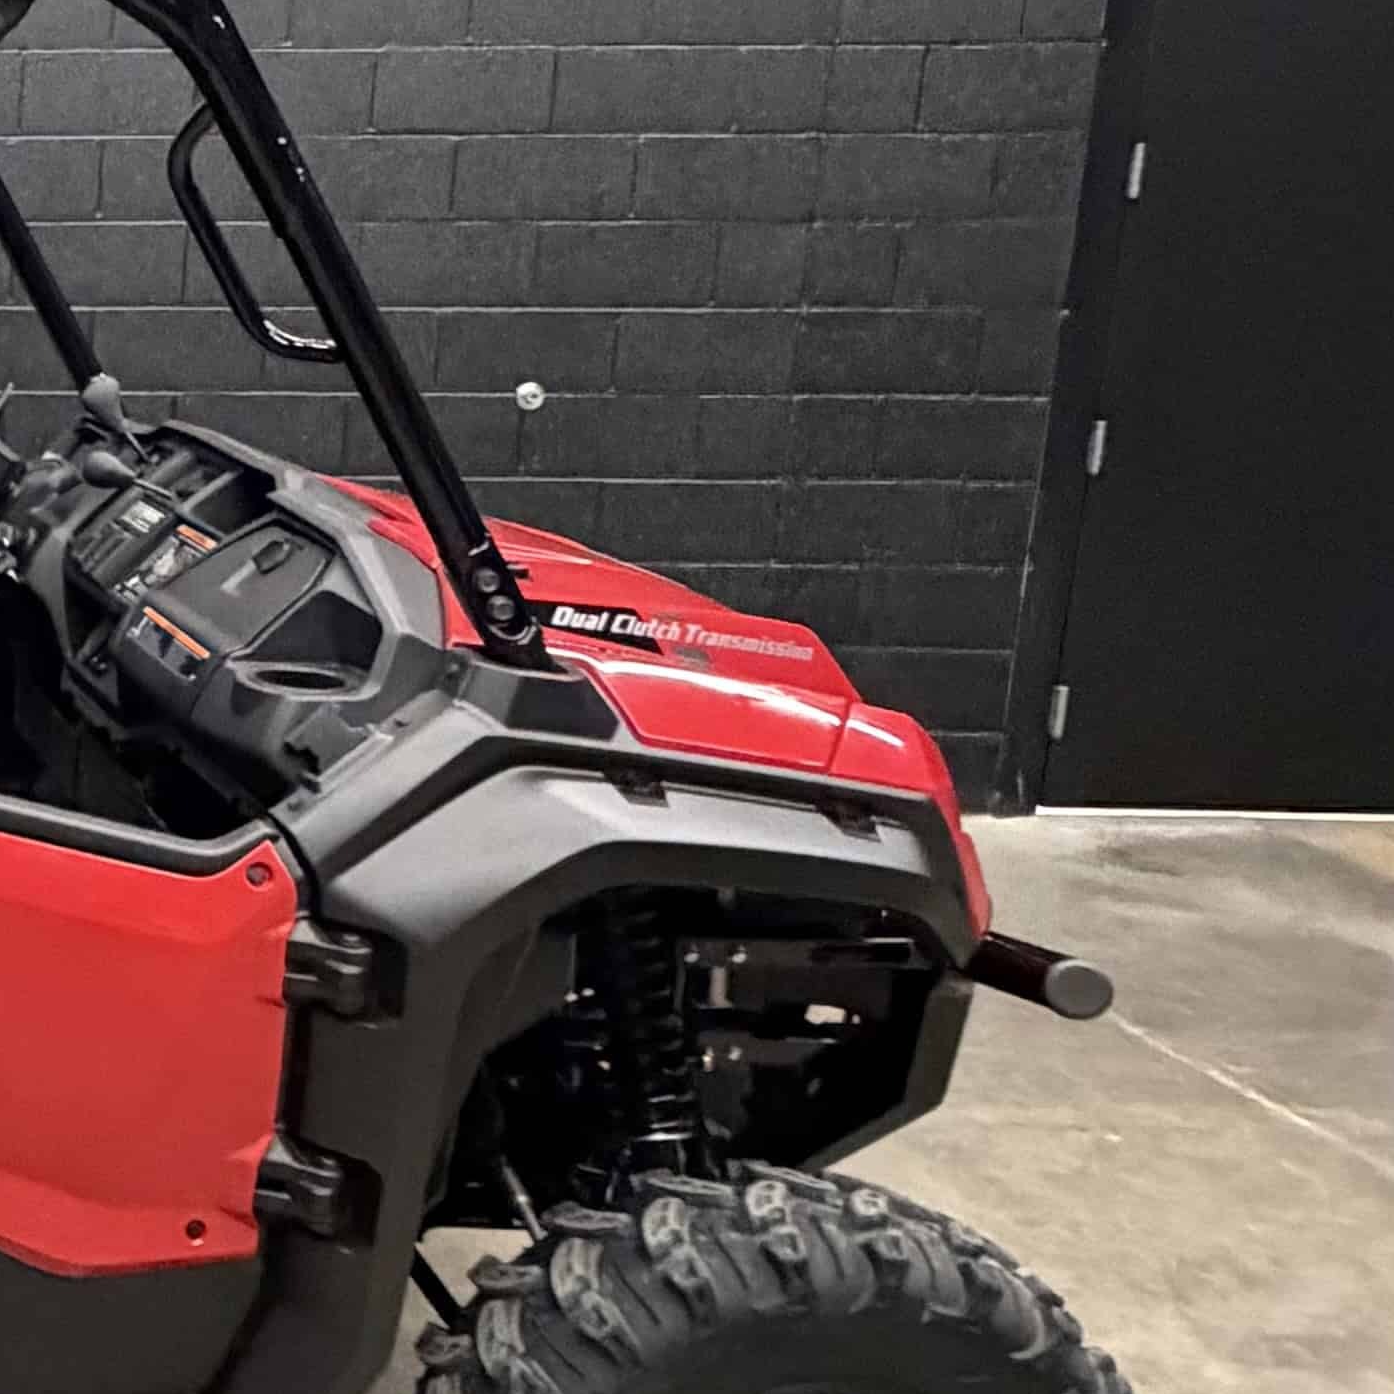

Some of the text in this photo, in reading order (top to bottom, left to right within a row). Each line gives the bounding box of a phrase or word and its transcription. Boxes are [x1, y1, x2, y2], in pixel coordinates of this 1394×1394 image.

[550, 605, 814, 662] Dual Clutch Transmission
